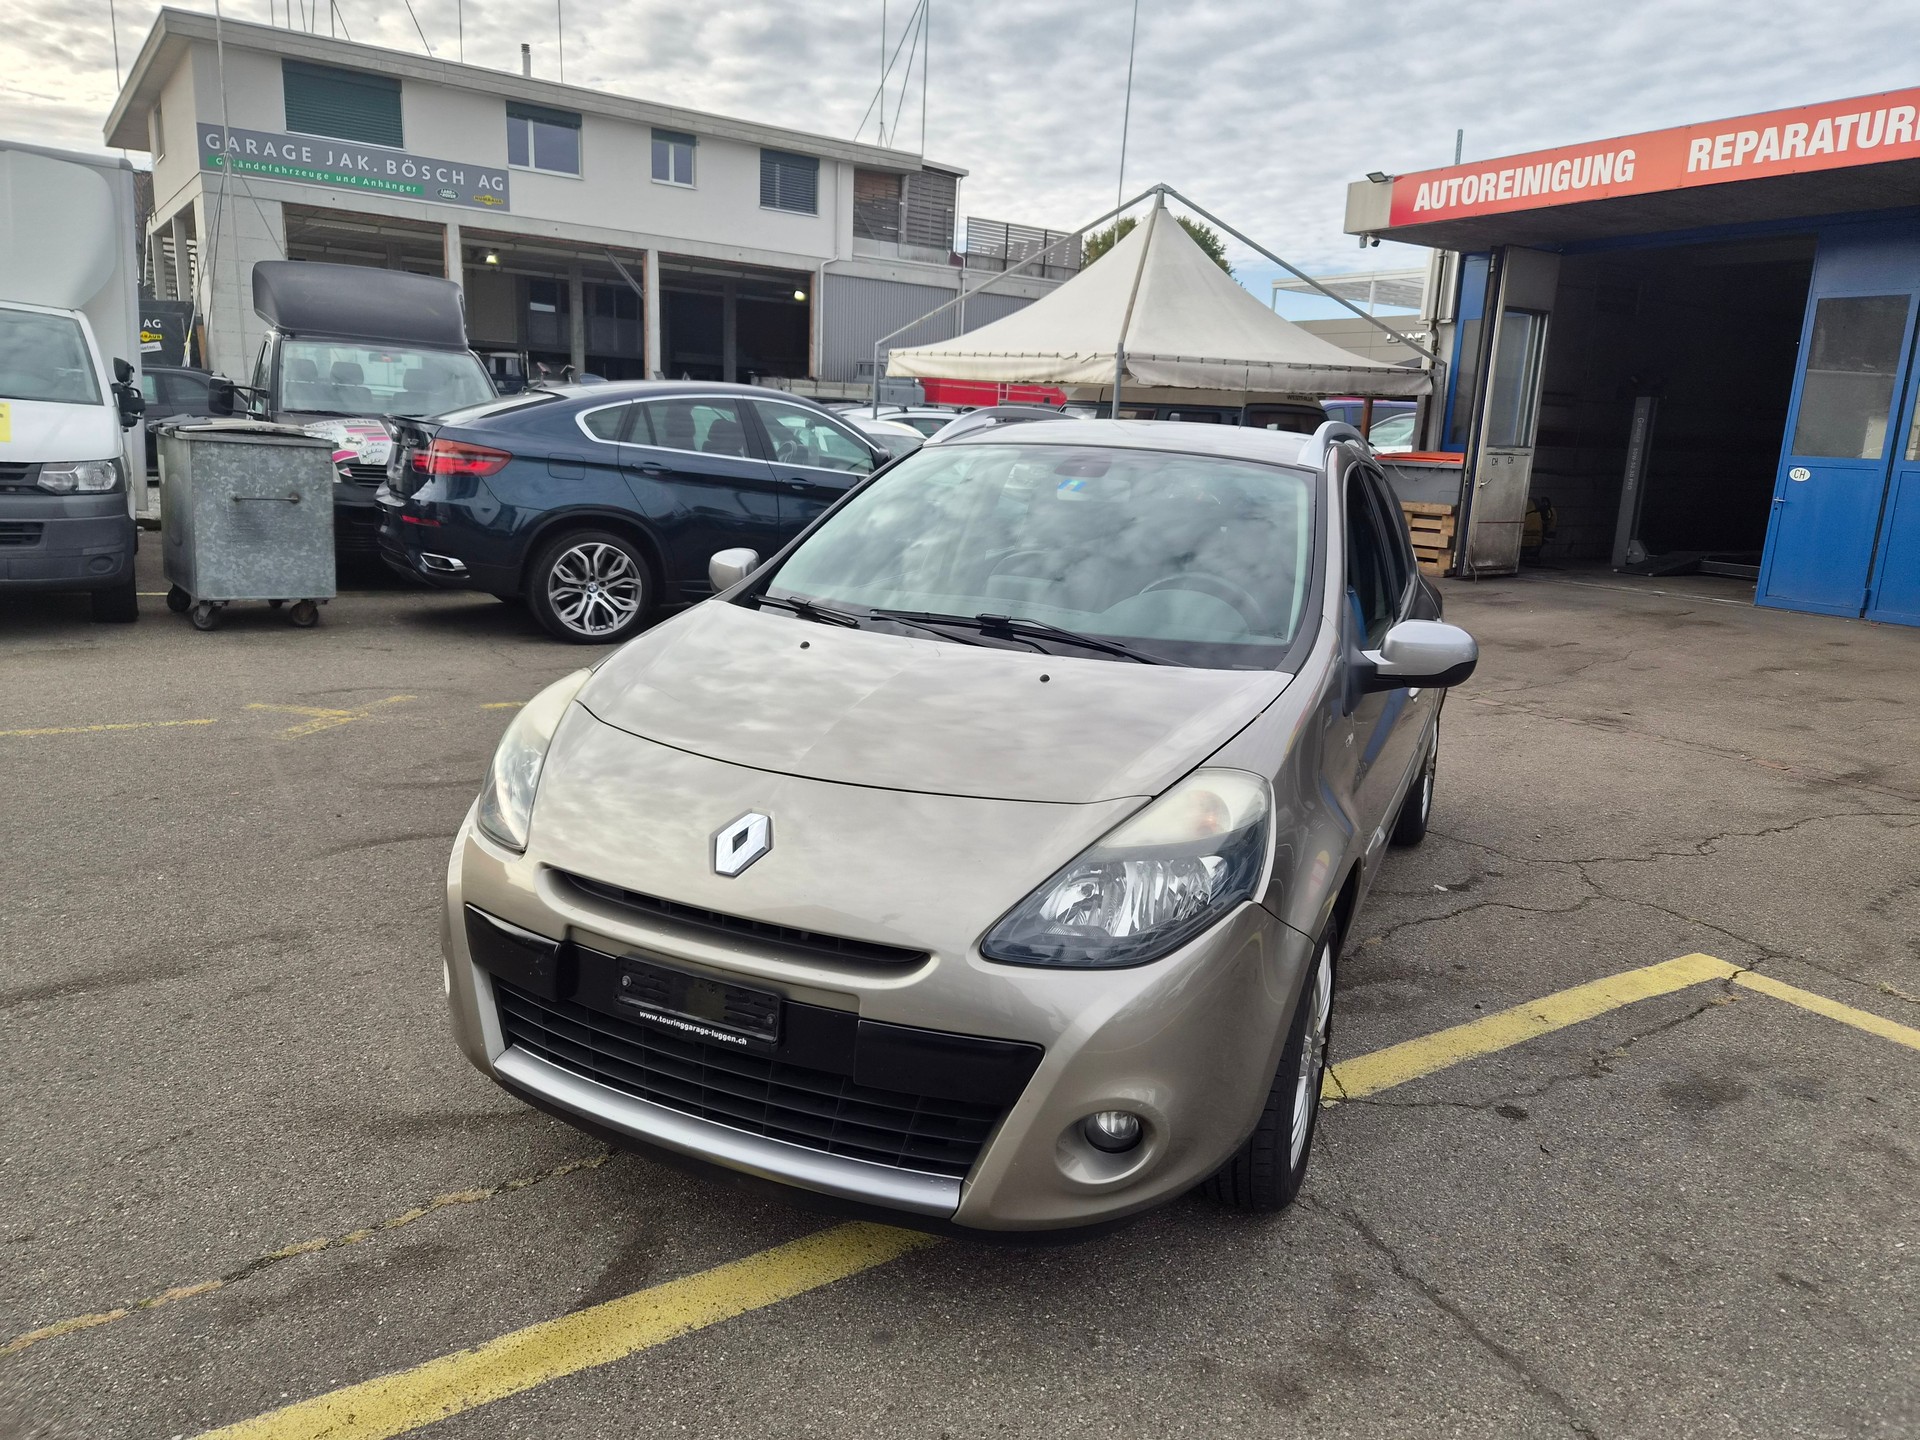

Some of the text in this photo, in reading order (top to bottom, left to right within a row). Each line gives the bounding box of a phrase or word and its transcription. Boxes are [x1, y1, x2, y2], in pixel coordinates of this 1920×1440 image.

[205, 133, 504, 191] GARAGE JAK. BÖSCH AG
[215, 157, 417, 193] Gändefahrzeuge und Anhänger
[1412, 105, 1920, 212] AUTOREINIGUNG REPARATUR
[143, 318, 162, 329] AG
[1793, 469, 1807, 480] CH
[639, 1010, 748, 1046] www.touringgarage-luggen.ch
